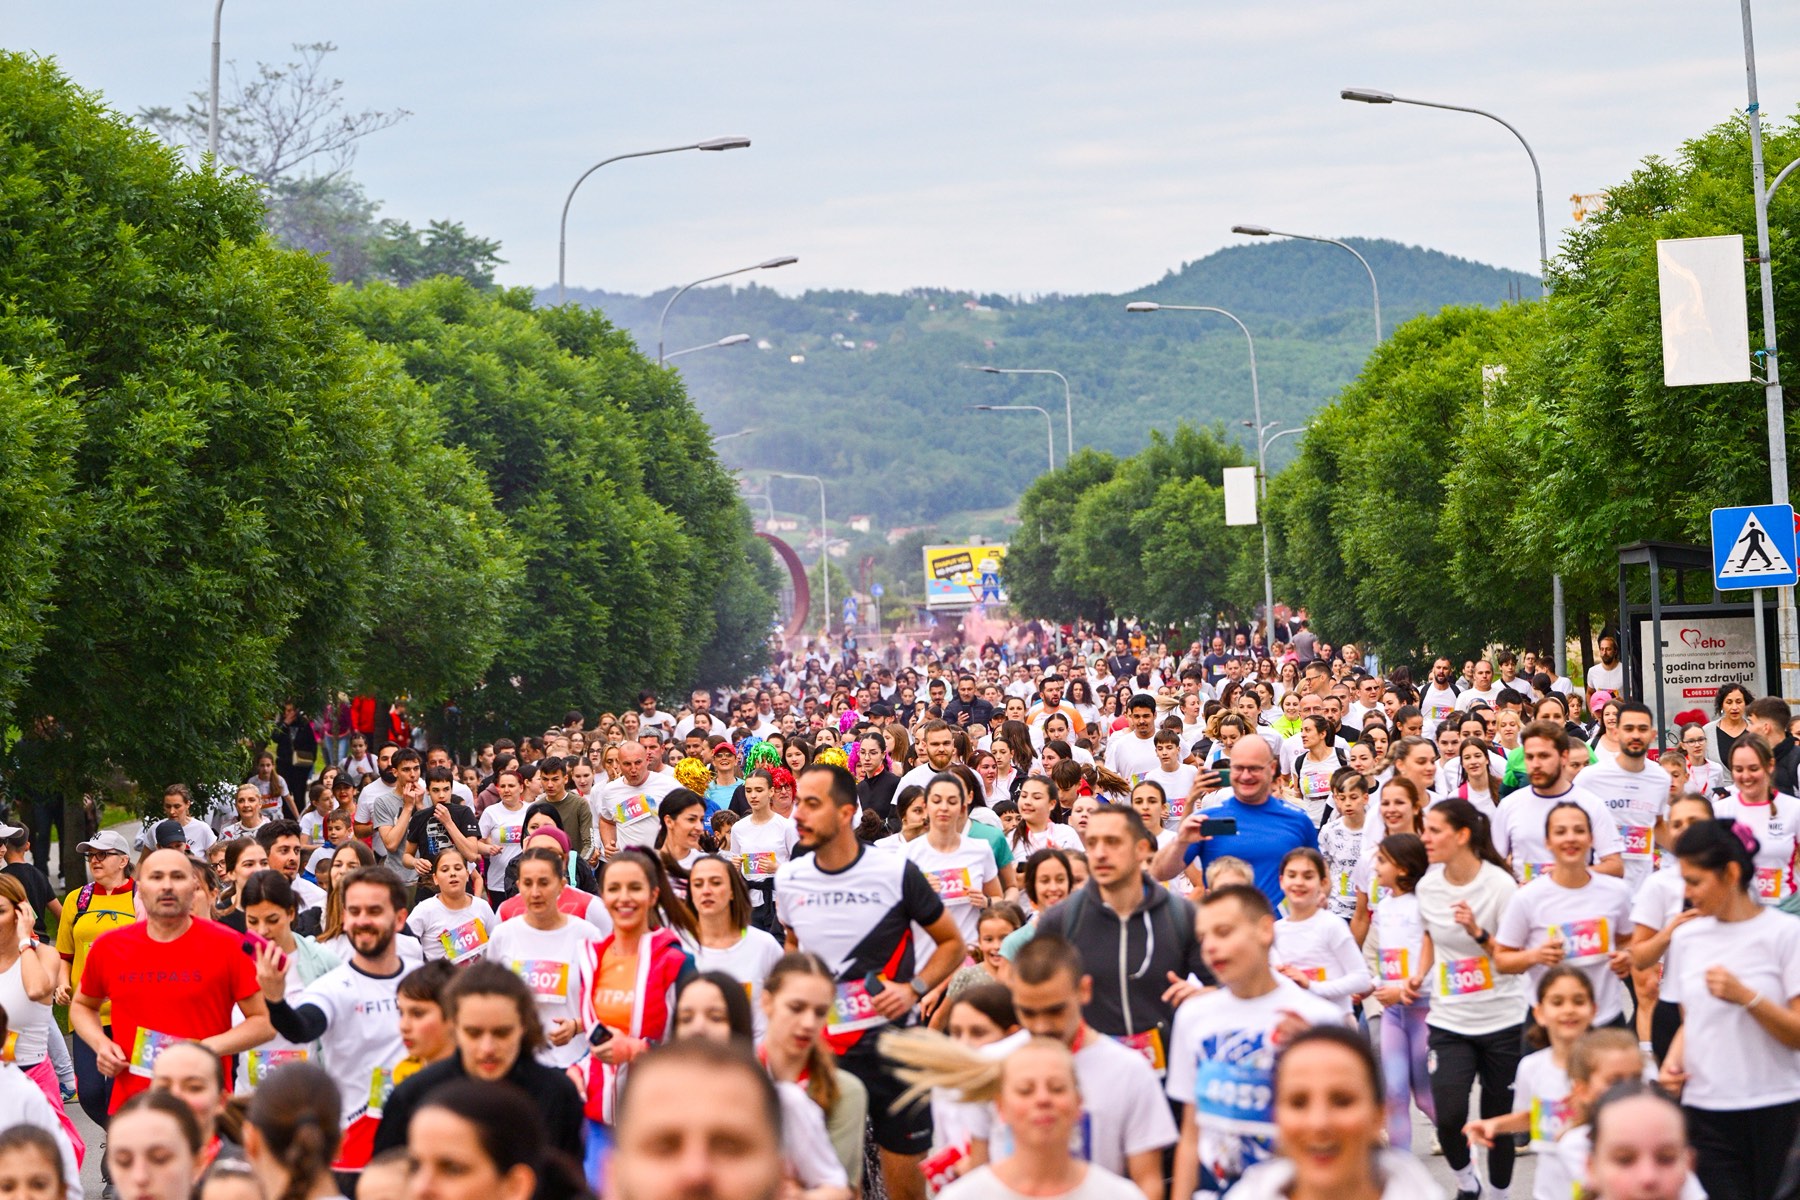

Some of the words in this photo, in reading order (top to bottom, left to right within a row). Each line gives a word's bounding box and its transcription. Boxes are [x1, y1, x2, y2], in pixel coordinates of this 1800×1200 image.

[1666, 661, 1706, 675] godina
[1708, 659, 1756, 670] brinemo
[1664, 674, 1703, 685] vašem
[1705, 672, 1754, 684] zdravlju!
[1309, 779, 1330, 793] 3362
[624, 803, 642, 817] 4118
[505, 832, 521, 841] 332
[940, 879, 963, 893] 223
[807, 892, 881, 906] FITPASS
[454, 931, 480, 950] 4191
[128, 970, 203, 983] FITPASS
[1446, 970, 1485, 989] 3308
[835, 993, 872, 1016] 333
